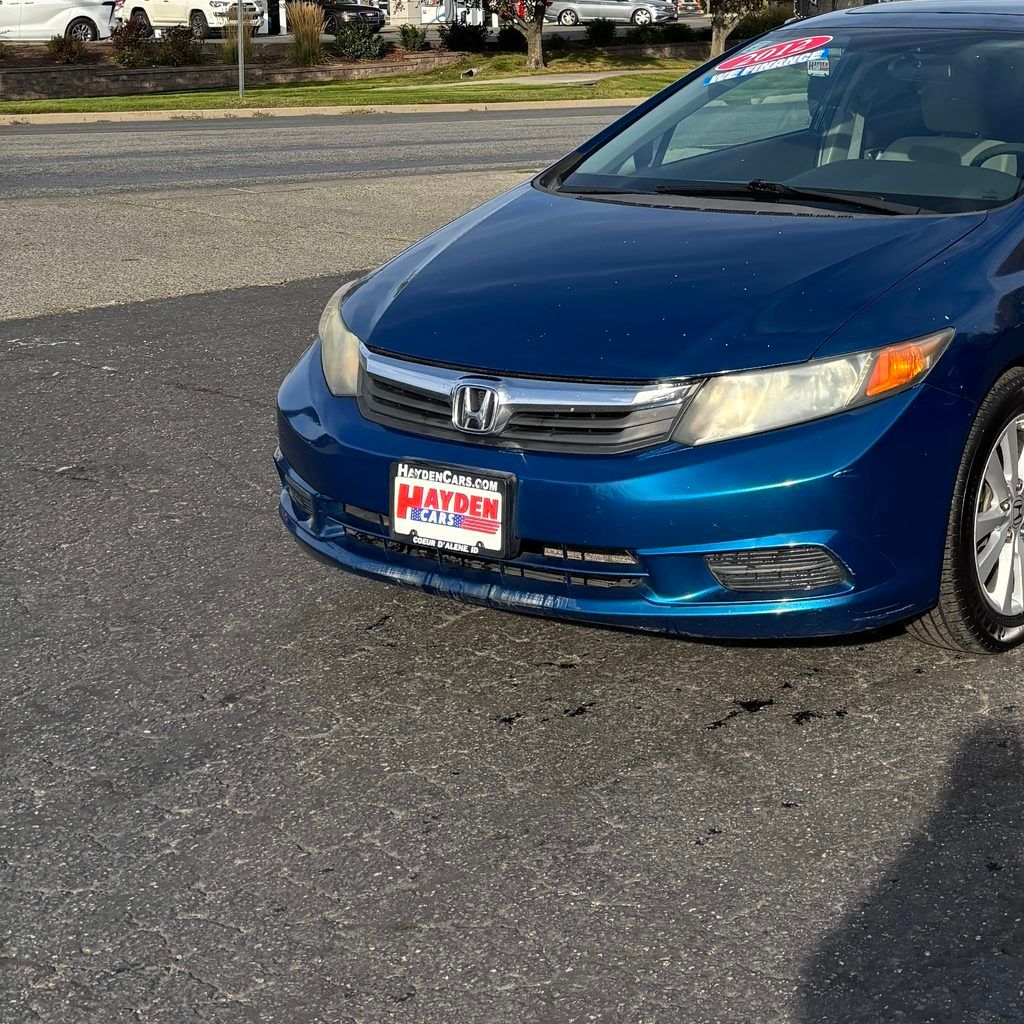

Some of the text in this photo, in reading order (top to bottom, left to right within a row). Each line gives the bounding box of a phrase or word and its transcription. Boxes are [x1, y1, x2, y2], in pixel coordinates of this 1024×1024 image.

[734, 38, 813, 66] 2012
[741, 49, 826, 76] FINANCE
[397, 483, 499, 520] HAYDEN
[420, 508, 455, 527] CARS
[412, 536, 436, 547] COEUR
